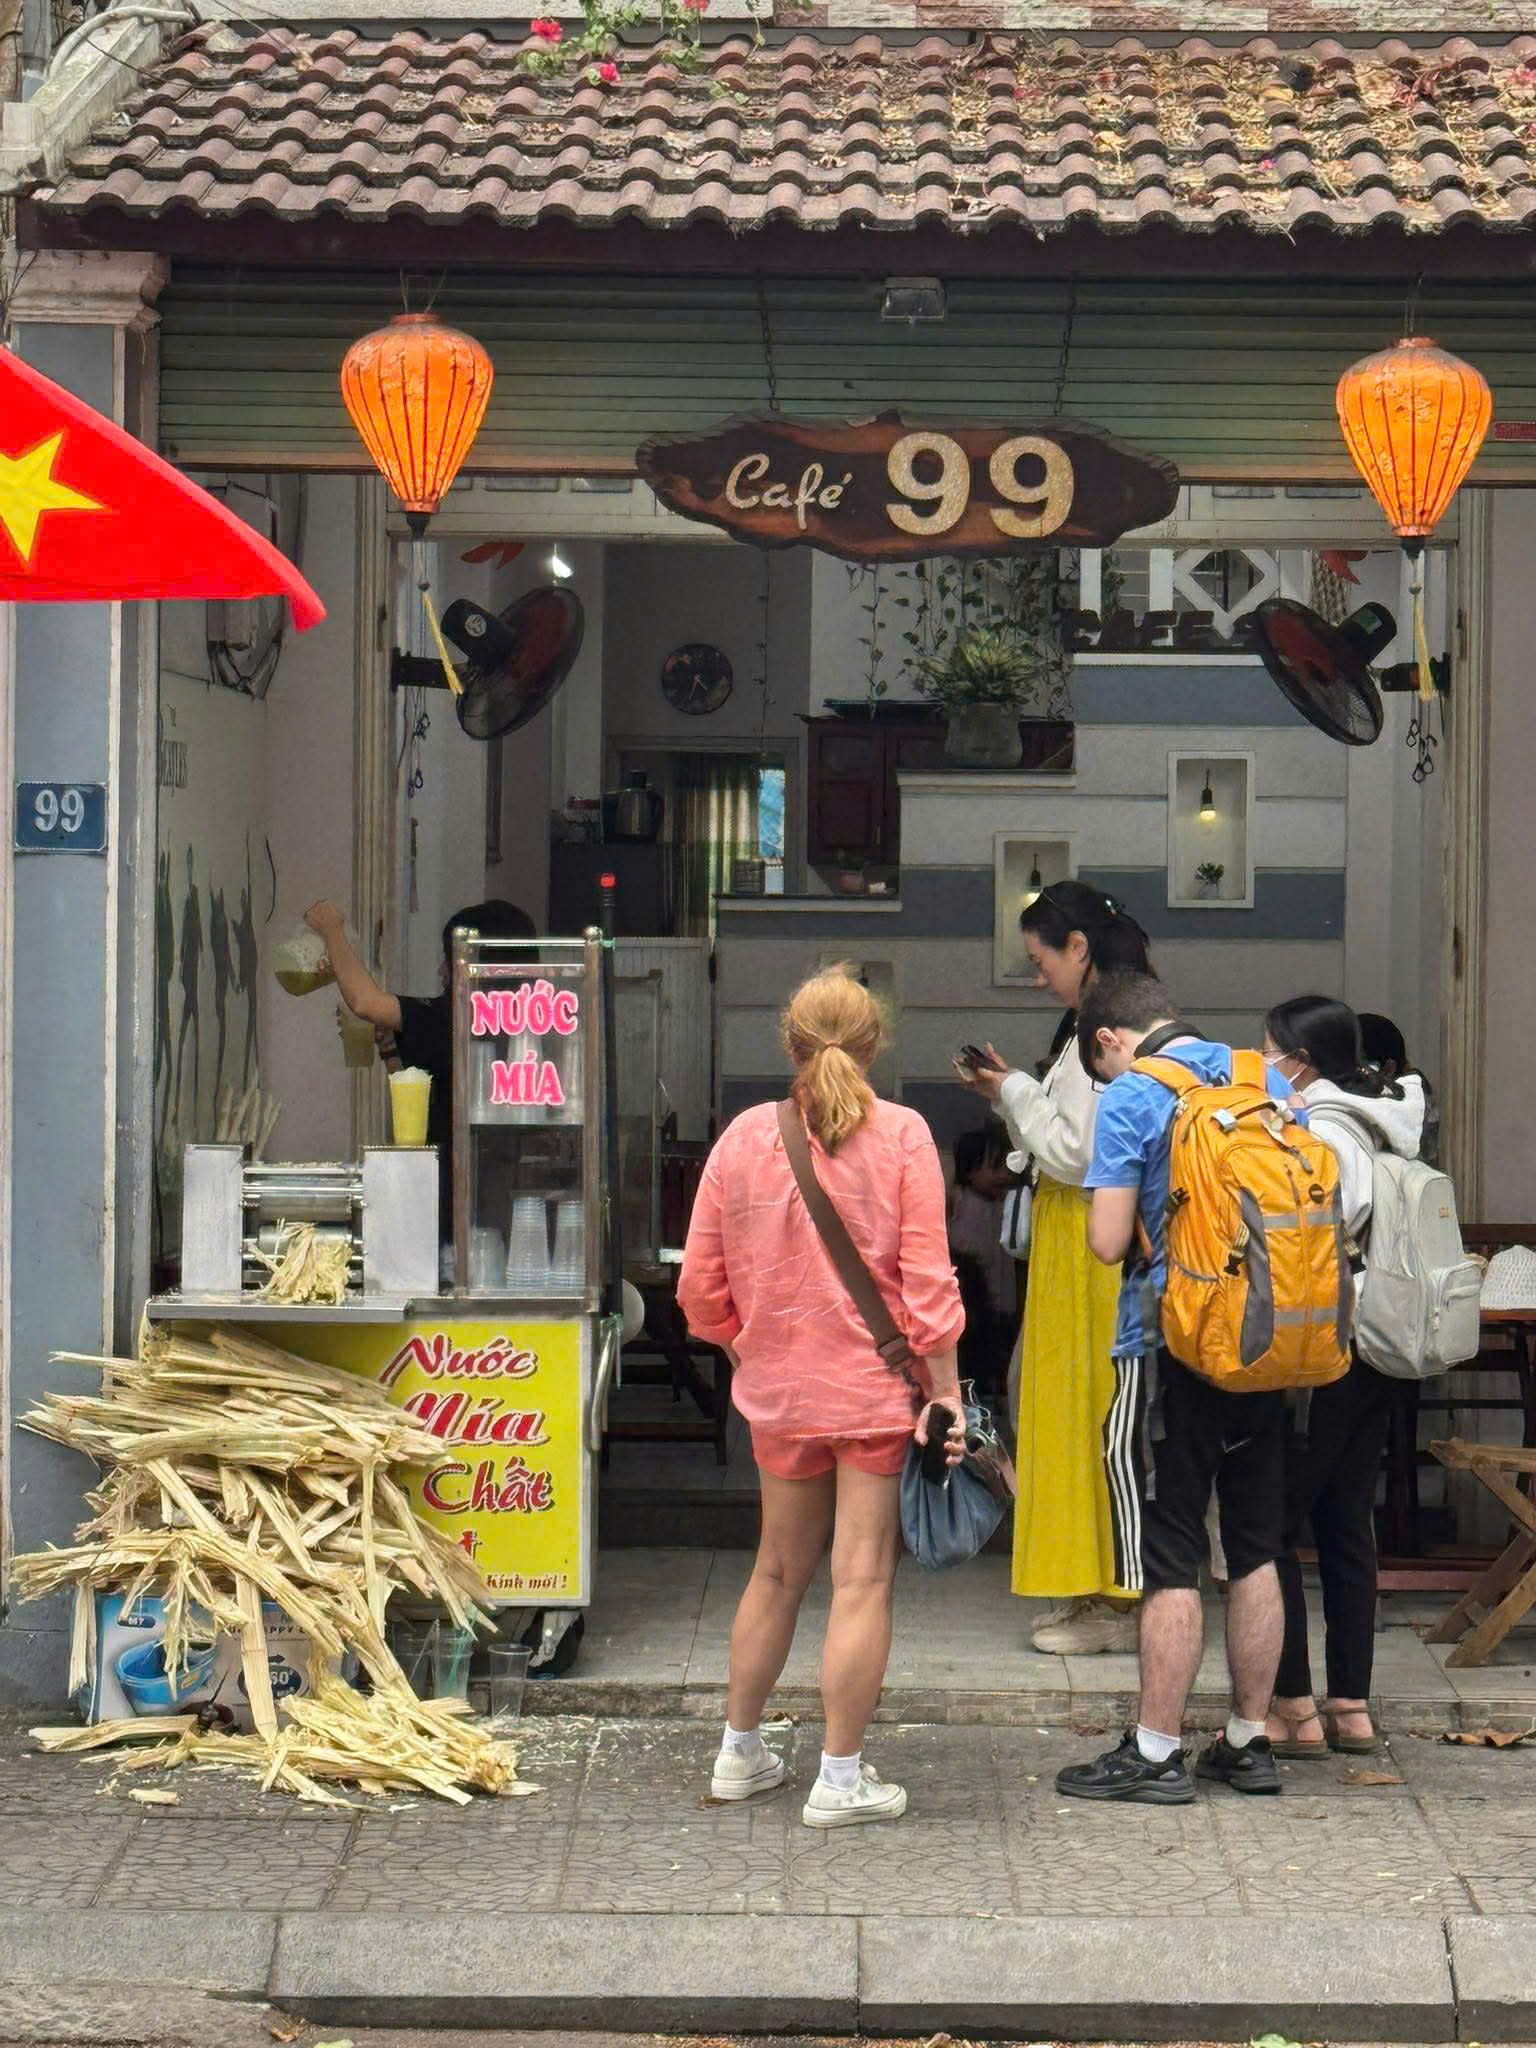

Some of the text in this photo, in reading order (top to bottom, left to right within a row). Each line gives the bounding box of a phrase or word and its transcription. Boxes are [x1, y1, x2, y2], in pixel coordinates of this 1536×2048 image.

[725, 432, 1074, 538] Café 99
[35, 789, 85, 832] 99
[471, 979, 578, 1035] NƯỚC
[491, 1049, 565, 1105] MÍA
[380, 1334, 538, 1383] Nước
[404, 1392, 550, 1446] Mía
[423, 1457, 555, 1513] Chất
